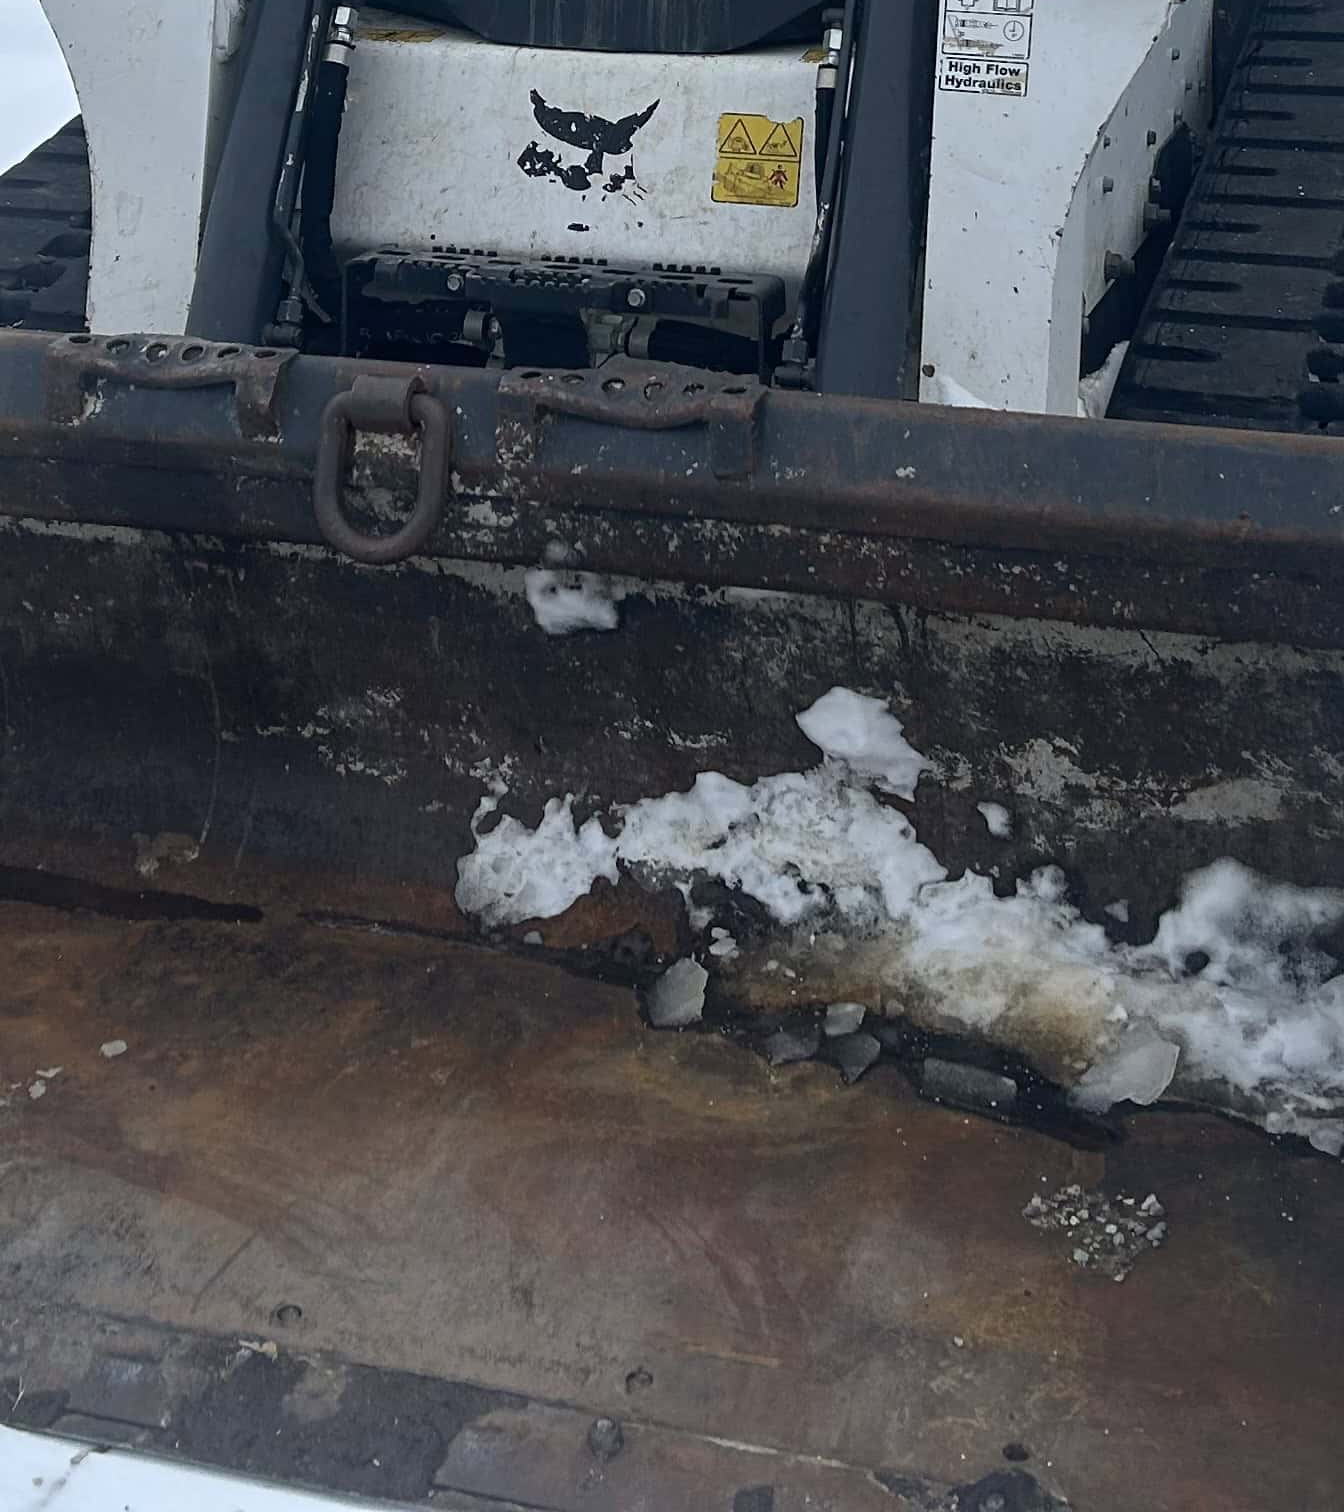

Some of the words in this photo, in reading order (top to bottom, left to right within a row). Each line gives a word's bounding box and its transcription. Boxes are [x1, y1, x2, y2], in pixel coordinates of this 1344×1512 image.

[948, 61, 981, 75] High
[986, 63, 1021, 77] Flow
[944, 74, 1022, 91] Hydraulics
